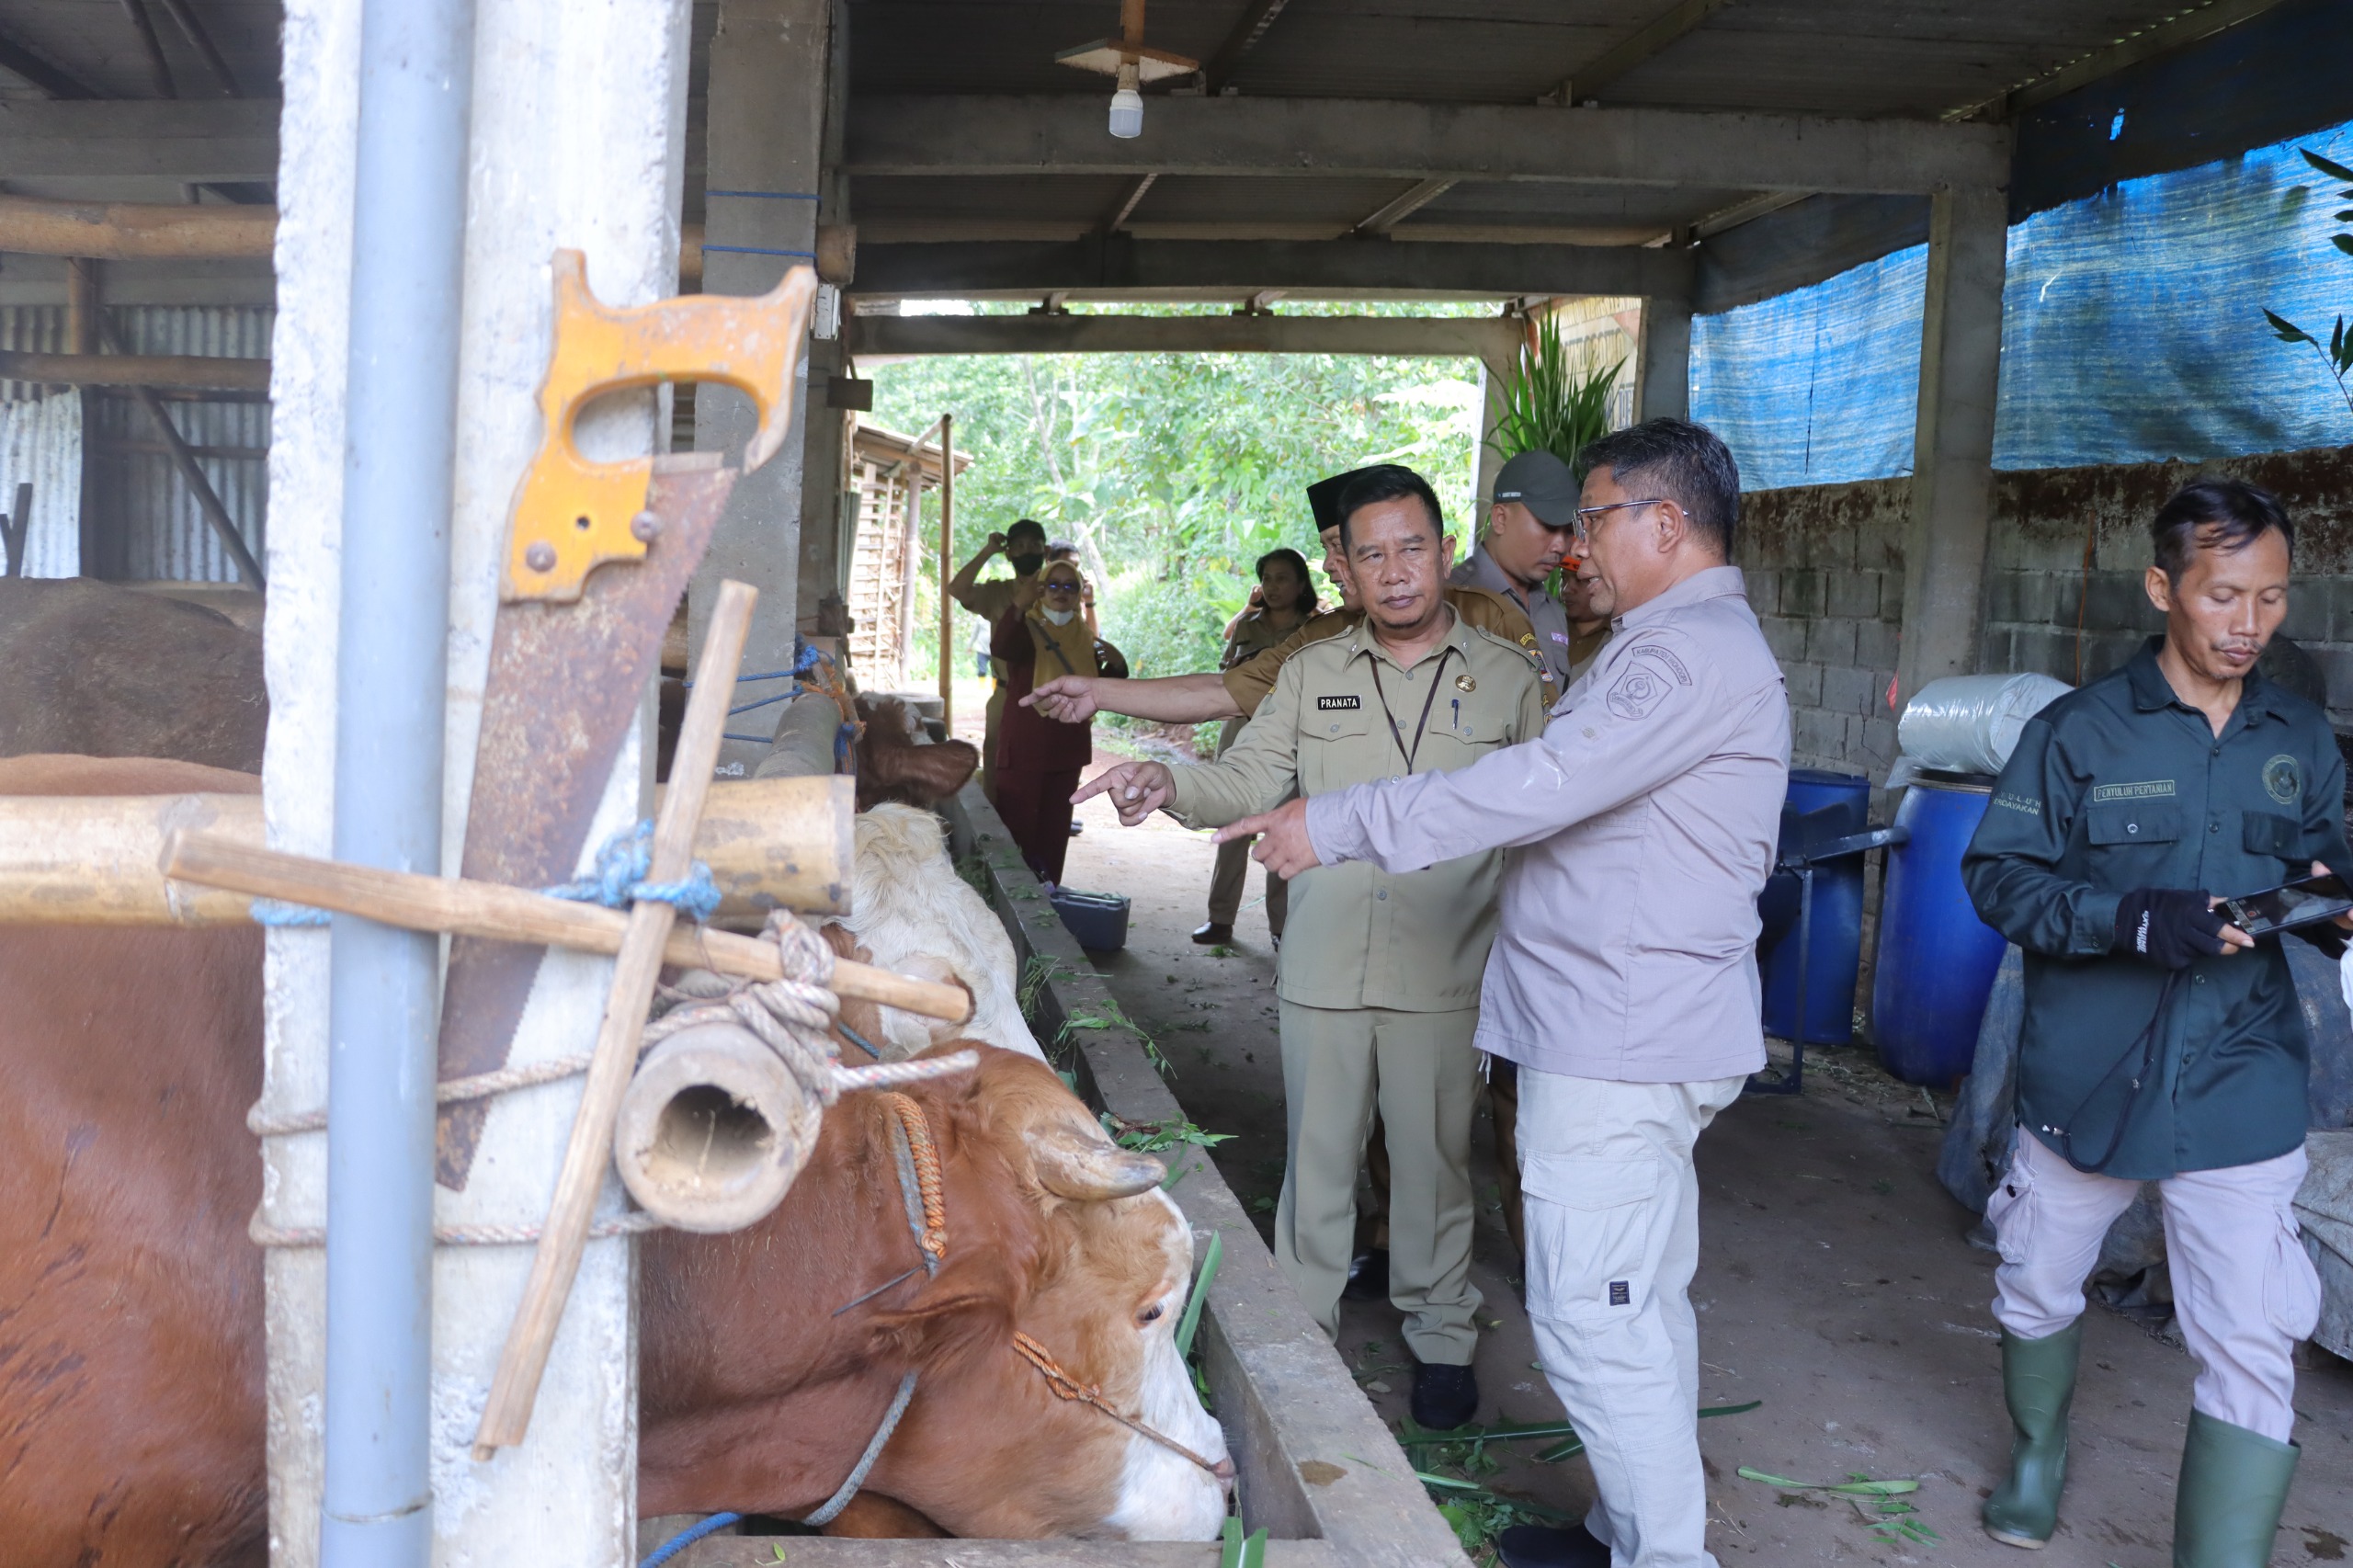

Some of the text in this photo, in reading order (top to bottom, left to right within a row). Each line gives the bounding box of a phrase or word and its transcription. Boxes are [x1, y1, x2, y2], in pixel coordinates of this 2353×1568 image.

[1321, 698, 1358, 708] PRANATA
[2097, 783, 2173, 798] PENYULUH PERTANIAN
